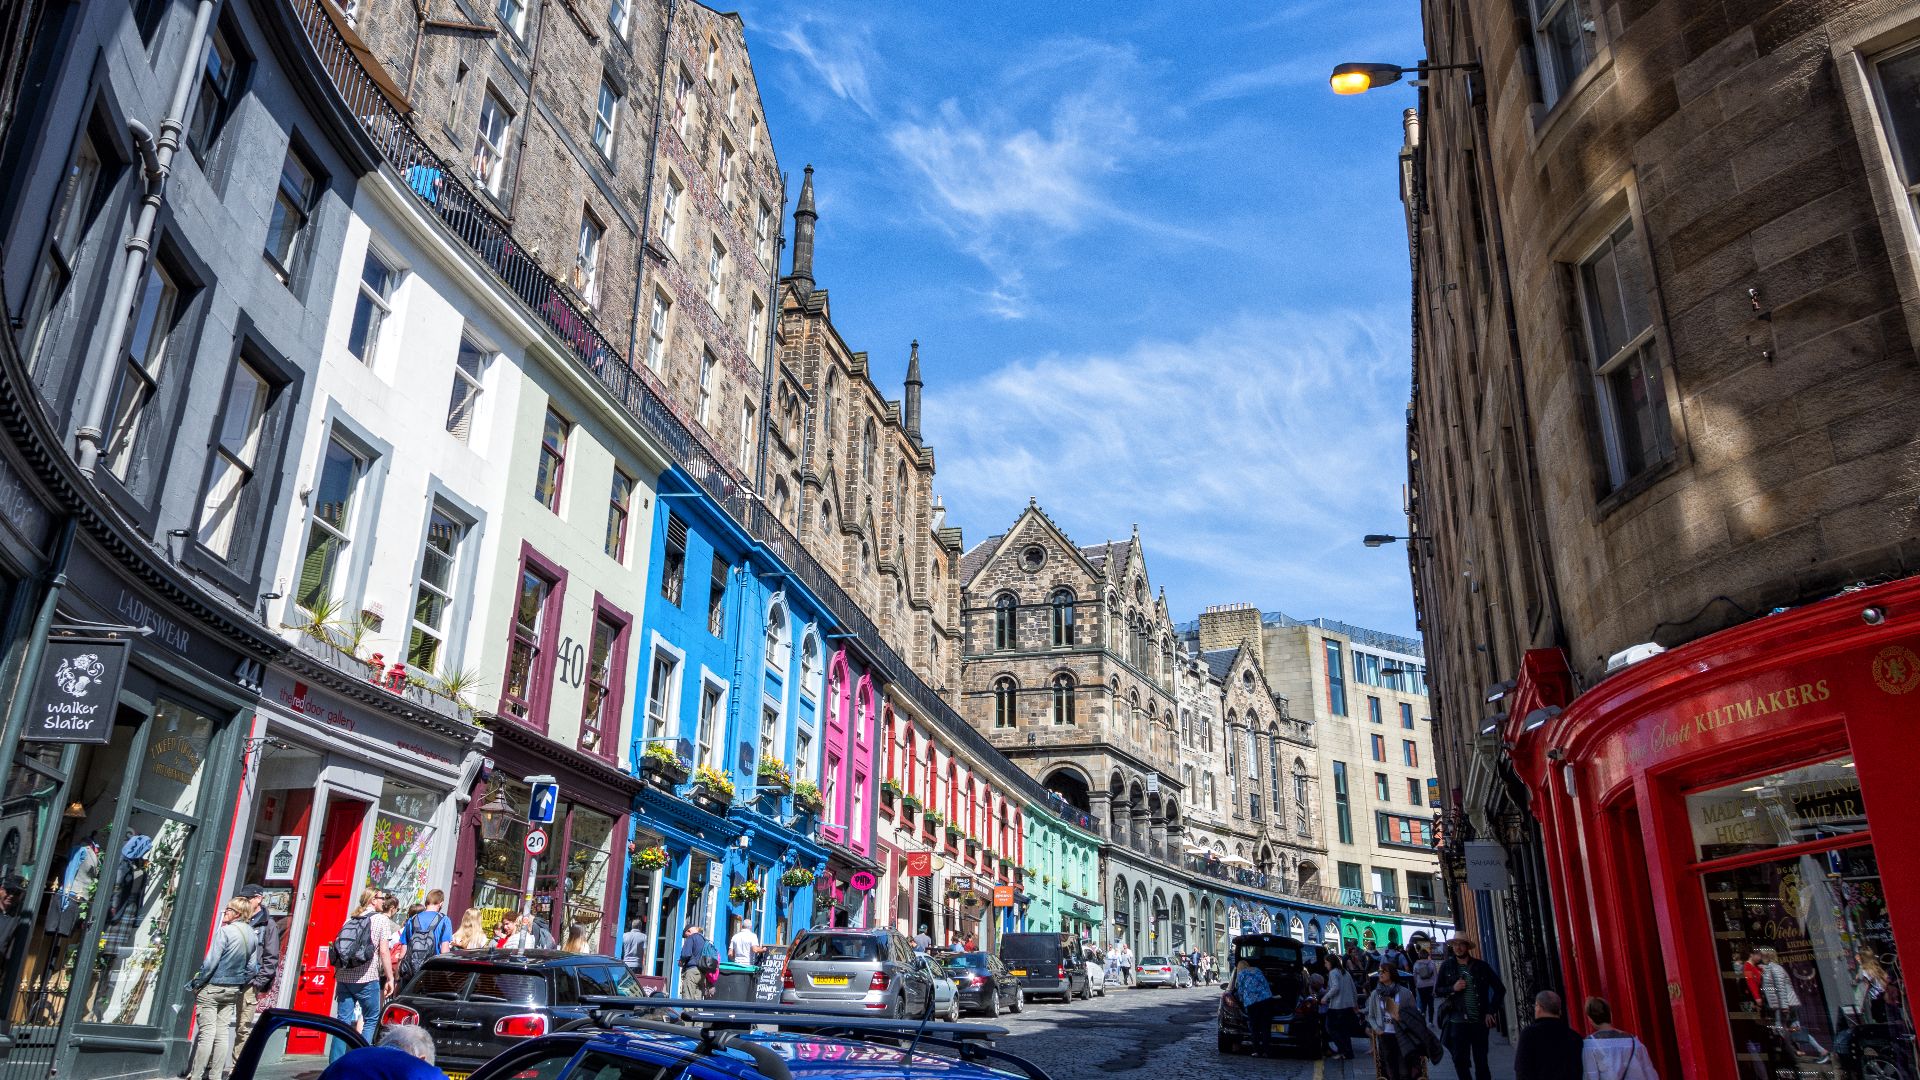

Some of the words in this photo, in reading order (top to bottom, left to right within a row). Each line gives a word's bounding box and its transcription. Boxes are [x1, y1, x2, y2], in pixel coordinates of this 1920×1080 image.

[117, 589, 190, 653] LADIESWEAR
[238, 656, 261, 691] 44
[556, 636, 584, 689] 40
[47, 701, 99, 715] walker
[327, 709, 356, 732] gallery
[1695, 679, 1830, 734] KILTMAKERS
[1803, 798, 1859, 827] WEAR
[528, 836, 544, 848] 20
[312, 974, 325, 986] 42
